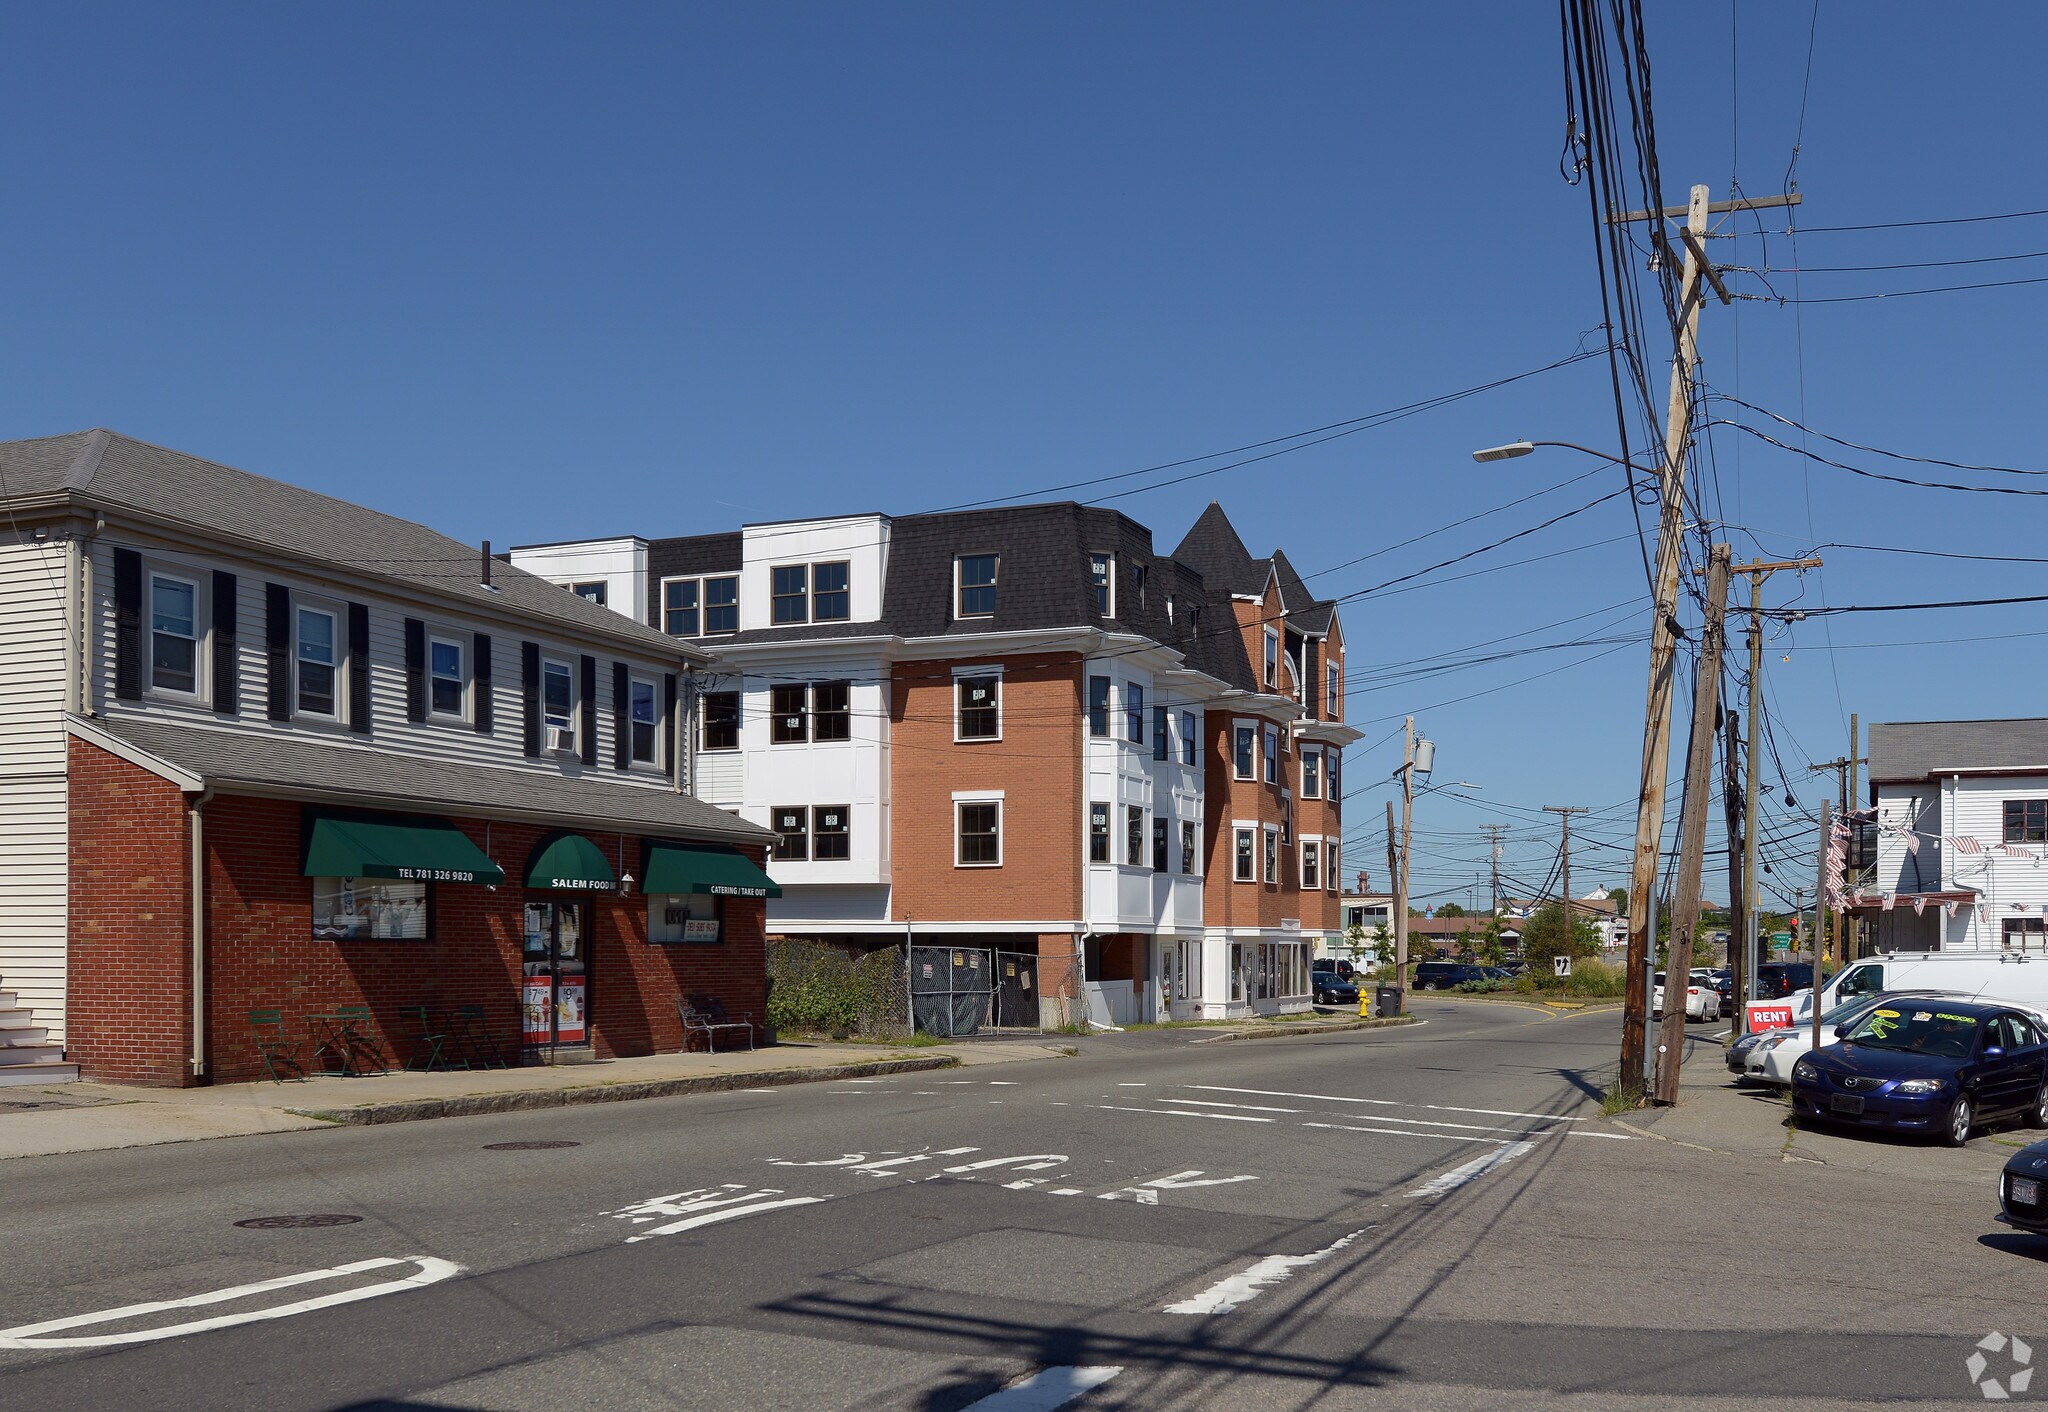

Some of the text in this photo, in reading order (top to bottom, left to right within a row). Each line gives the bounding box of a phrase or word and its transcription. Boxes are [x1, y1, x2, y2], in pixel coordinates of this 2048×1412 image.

[399, 868, 473, 882] TEL 781 326 9820
[551, 878, 587, 889] SALEM
[589, 880, 610, 890] FOOD
[710, 885, 738, 895] CATERING
[741, 887, 754, 896] TAKE
[755, 888, 766, 896] OUT
[1753, 1011, 1787, 1023] RENT
